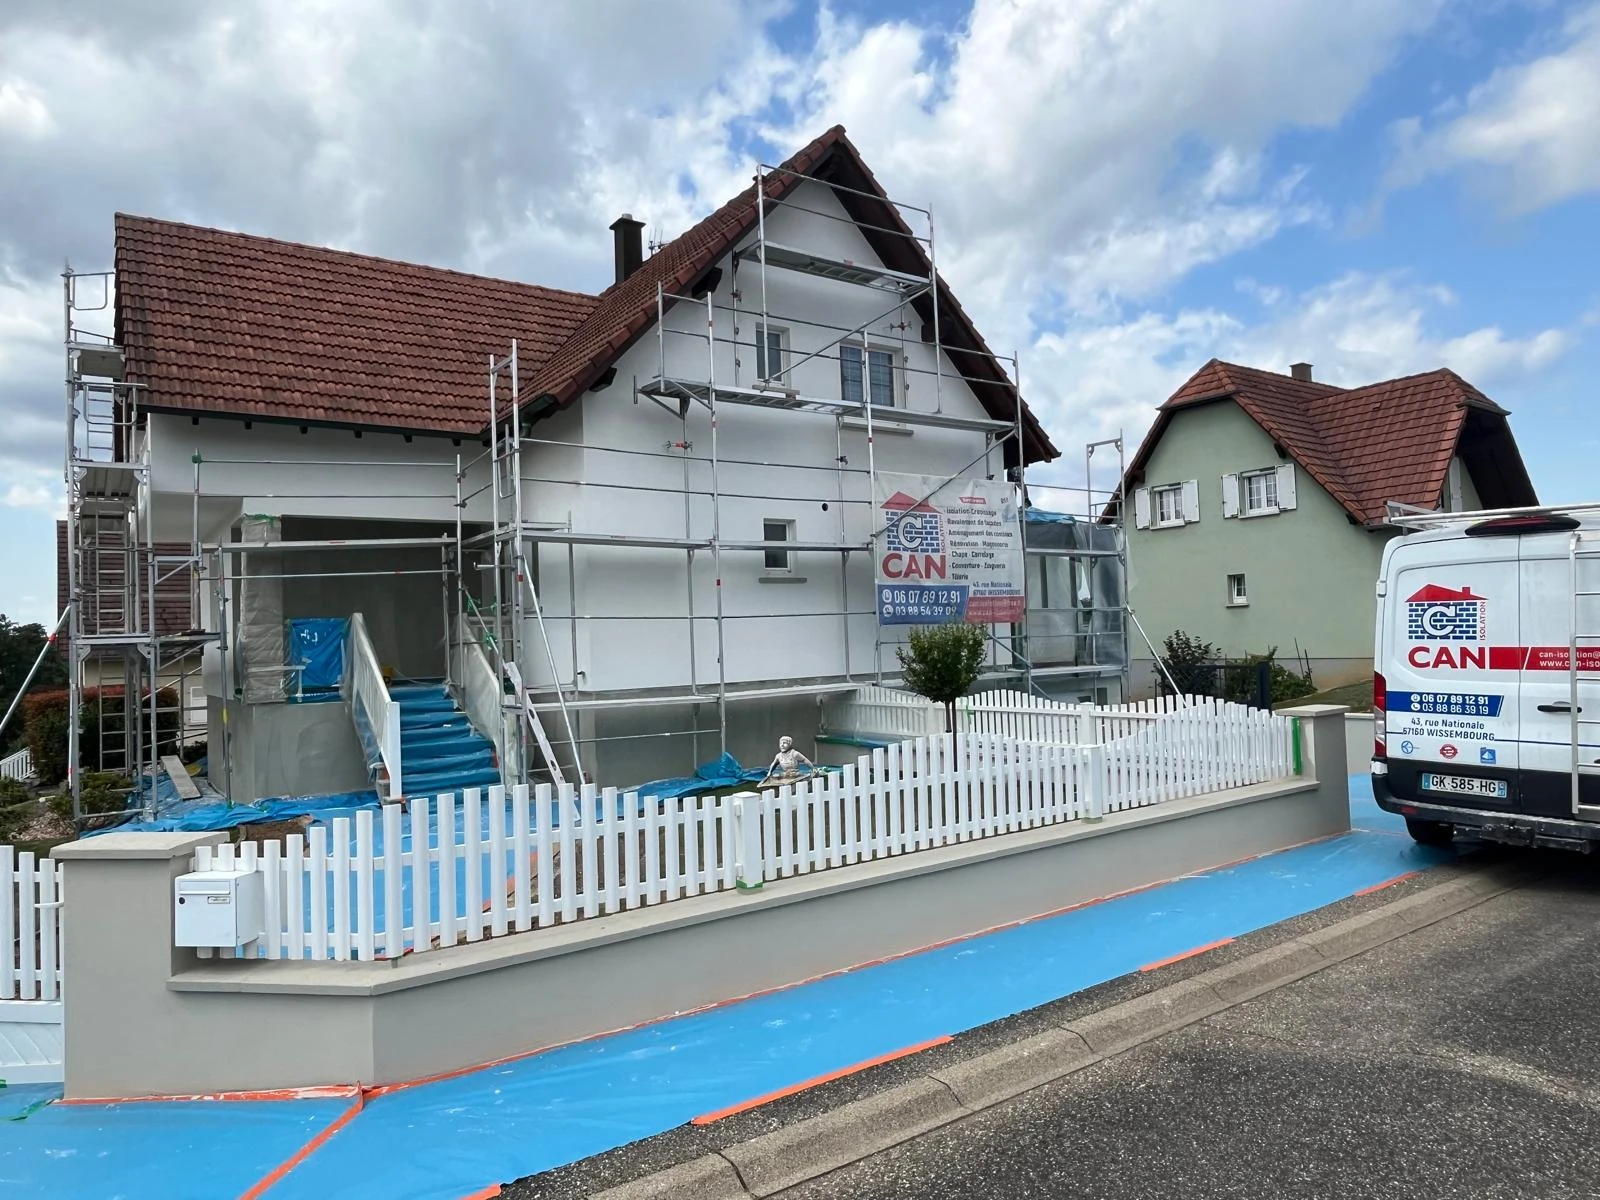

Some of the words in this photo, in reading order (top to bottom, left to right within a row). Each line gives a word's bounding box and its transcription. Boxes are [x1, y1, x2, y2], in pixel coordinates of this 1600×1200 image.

[882, 552, 946, 579] CAN
[894, 591, 906, 603] 06
[908, 591, 919, 603] 07
[923, 591, 935, 603] 89
[938, 592, 948, 603] 12
[950, 591, 960, 603] 91
[896, 606, 906, 615] 03
[908, 606, 918, 616] 88
[920, 606, 931, 616] 54
[933, 606, 943, 616] 39
[1407, 646, 1486, 669] CAN
[1422, 694, 1434, 703] 06
[1437, 694, 1448, 703] 07
[1450, 695, 1462, 704] 89
[1465, 696, 1475, 704] 12
[1478, 696, 1489, 705] 91
[1422, 703, 1433, 711] 03
[1436, 704, 1447, 712] 88
[1450, 704, 1462, 713] 86
[1464, 705, 1476, 714] 39
[1479, 706, 1488, 715] 19
[1411, 717, 1422, 727] 43,
[1425, 719, 1439, 727] rue
[1441, 719, 1485, 730] Nationale
[1427, 729, 1495, 741] WISSEMBOURG
